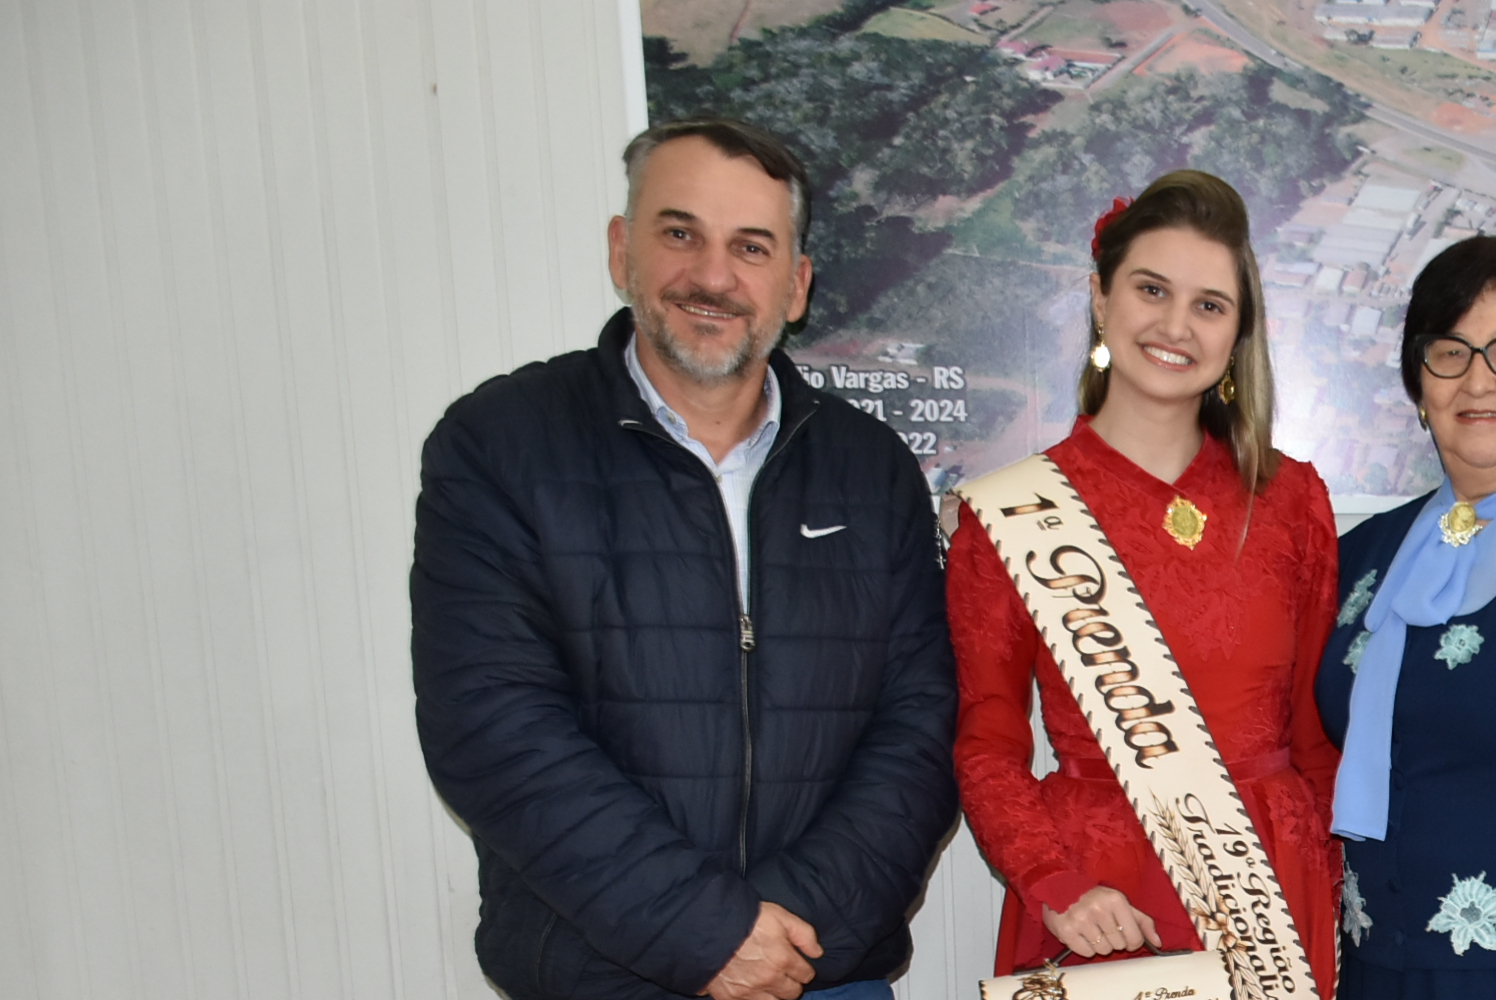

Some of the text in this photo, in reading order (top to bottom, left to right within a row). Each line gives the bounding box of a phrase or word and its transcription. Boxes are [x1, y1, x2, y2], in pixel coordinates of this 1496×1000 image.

[831, 365, 909, 393] Vargas
[933, 366, 965, 390] RS
[910, 399, 968, 422] 2024
[1026, 545, 1180, 769] Prenda
[1237, 872, 1296, 994] Região
[1153, 986, 1197, 1000] Prenda
